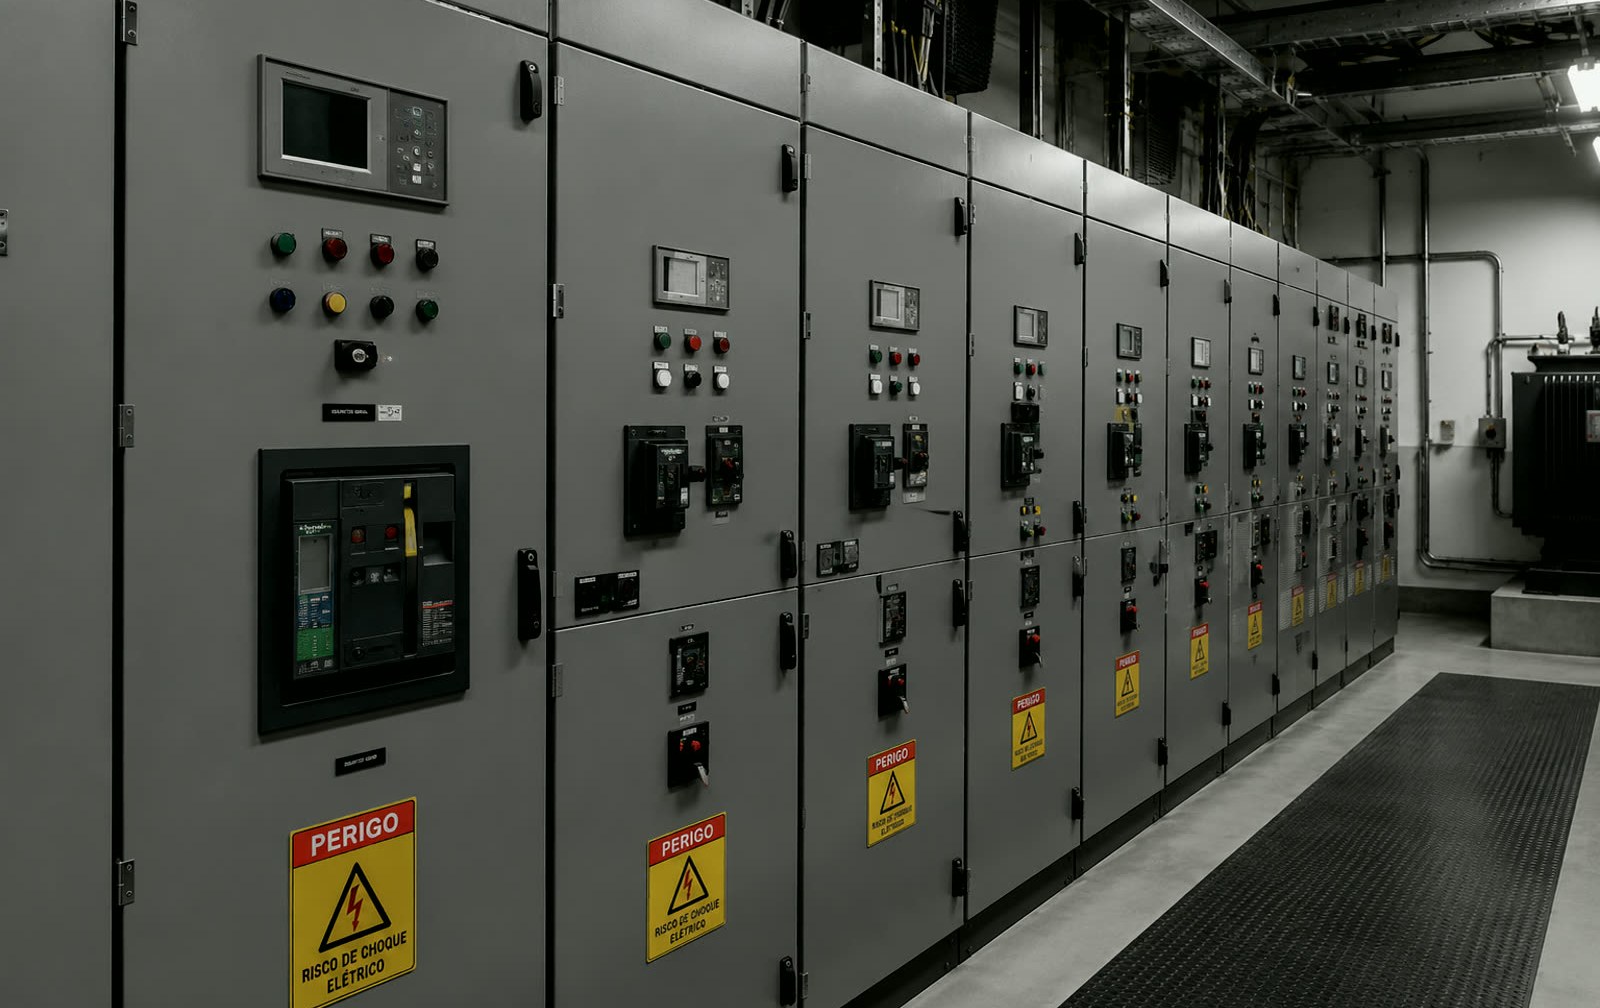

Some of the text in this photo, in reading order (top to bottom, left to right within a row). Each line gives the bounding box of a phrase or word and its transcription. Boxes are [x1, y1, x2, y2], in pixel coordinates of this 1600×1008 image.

[875, 748, 908, 770] PERIGO
[310, 812, 399, 857] PERIGO
[662, 823, 714, 857] PERIGO
[655, 898, 720, 938] RISCO DE CHOQUE
[302, 930, 407, 983] RISCO DE CHOQUE
[327, 958, 385, 993] ELÉTRICO
